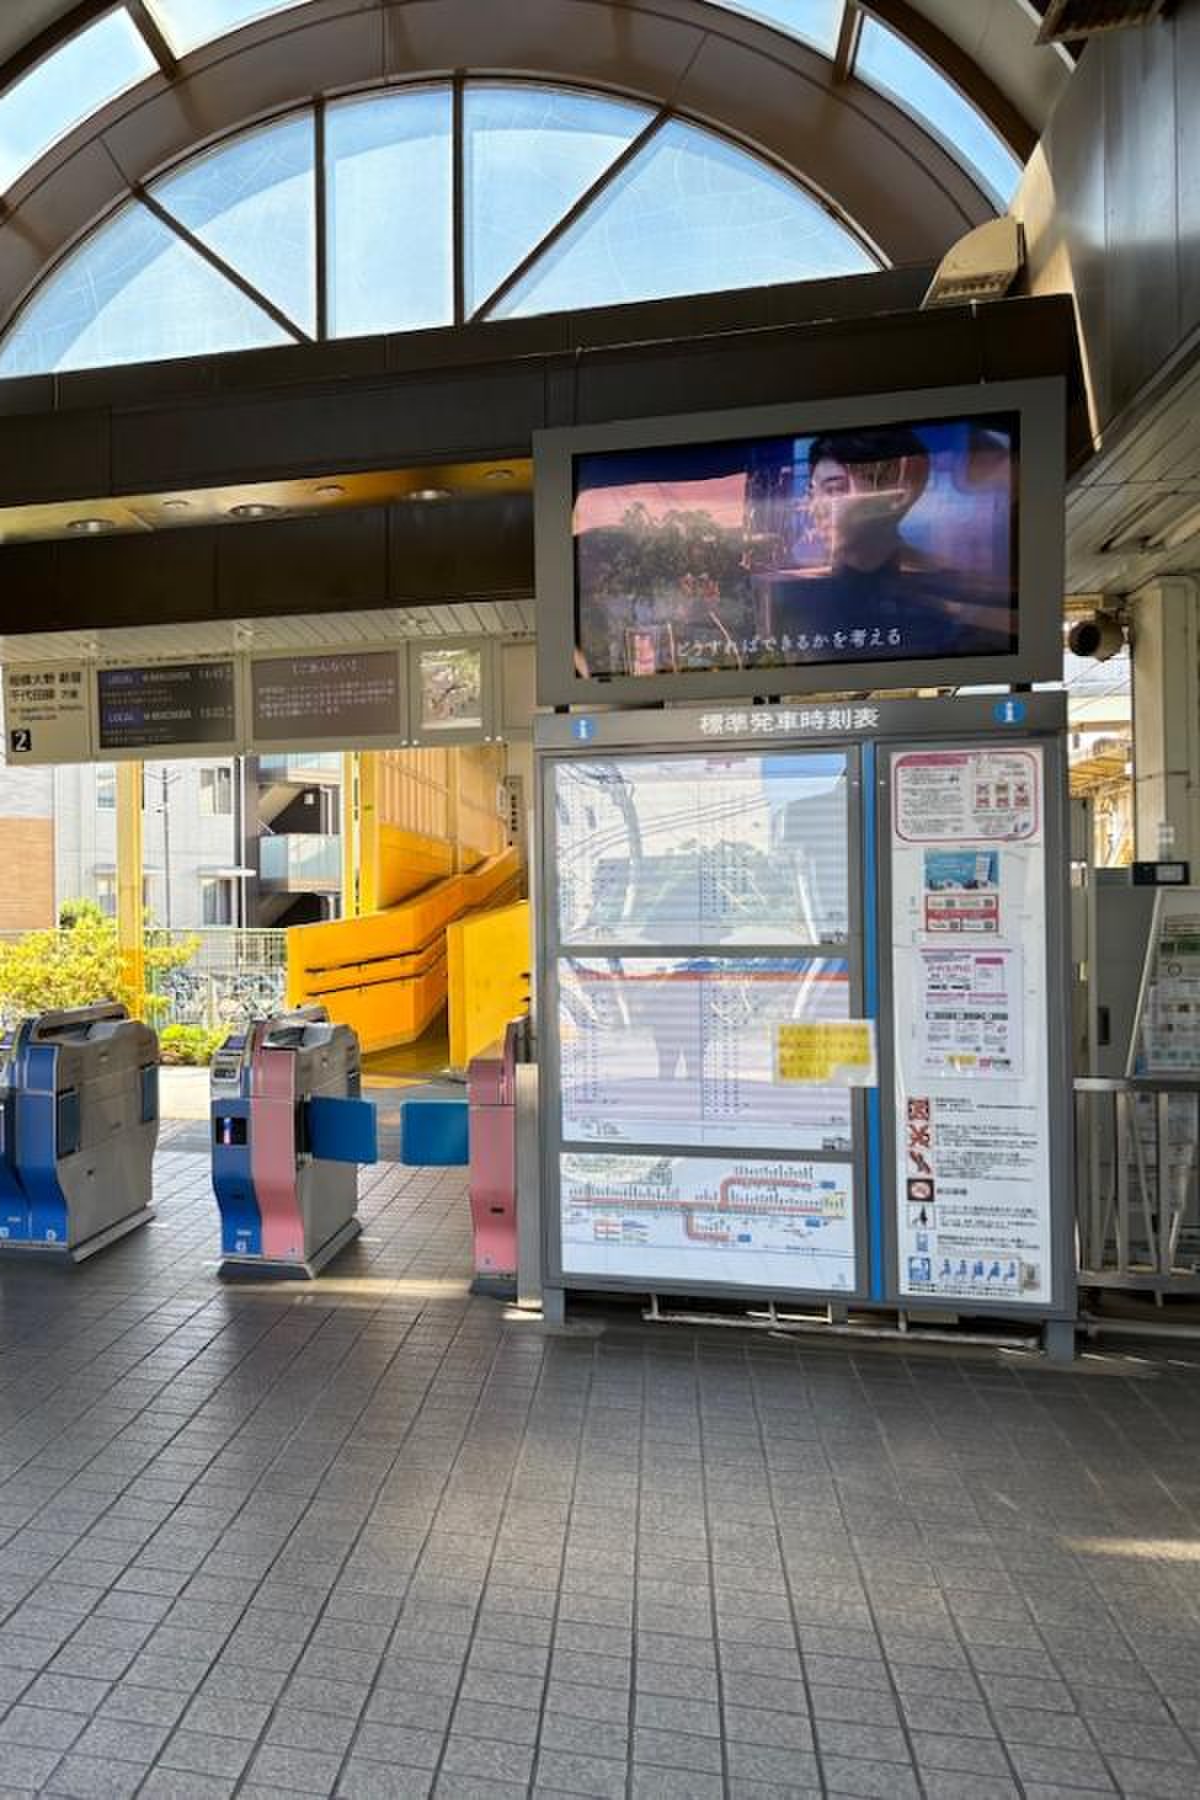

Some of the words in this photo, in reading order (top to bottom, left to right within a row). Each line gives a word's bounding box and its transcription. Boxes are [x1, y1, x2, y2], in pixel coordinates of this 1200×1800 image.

[700, 707, 881, 736] 標準発車時刻表
[14, 730, 28, 752] 2
